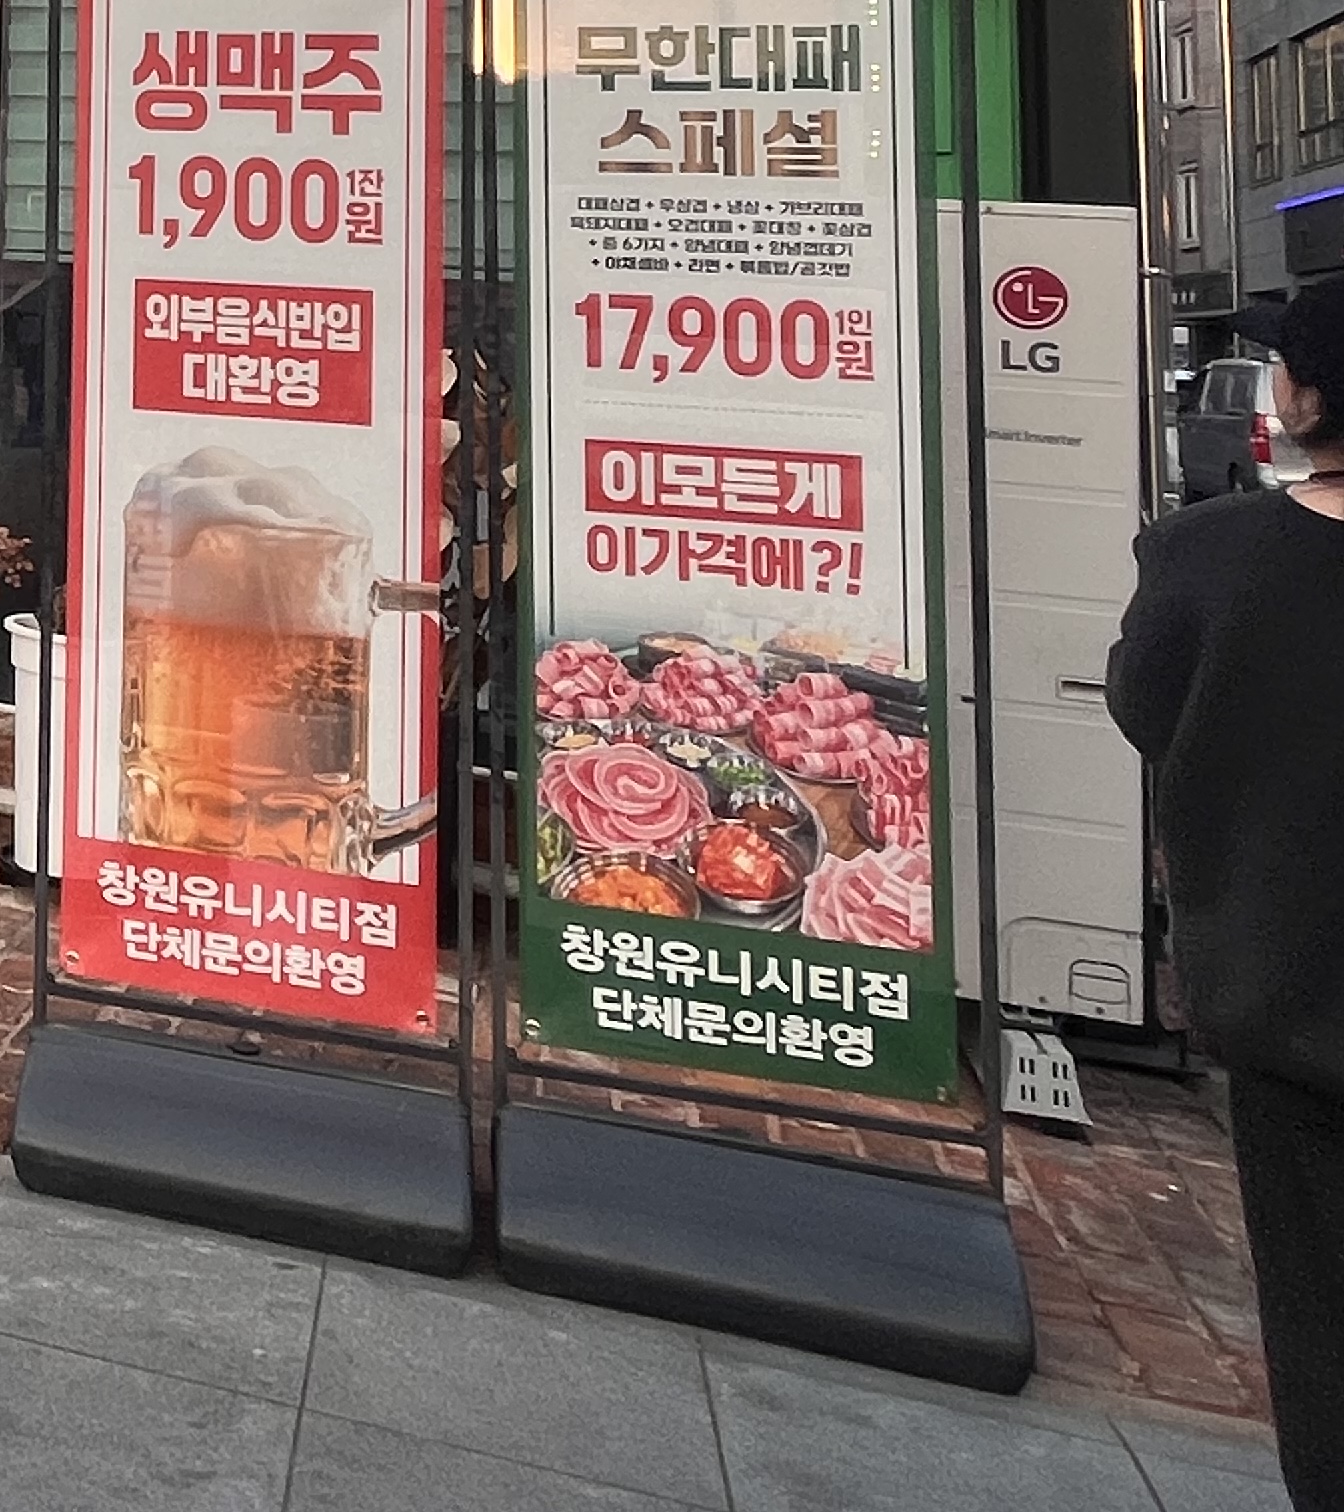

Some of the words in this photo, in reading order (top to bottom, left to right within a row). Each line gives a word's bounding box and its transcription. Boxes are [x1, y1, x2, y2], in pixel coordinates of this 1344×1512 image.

[133, 30, 382, 136] 생맥주
[576, 24, 862, 92] 무한대패
[598, 108, 840, 178] 스페셜
[128, 155, 340, 250] 1,900
[345, 201, 384, 245] 원
[144, 294, 361, 353] 외부음식반입
[574, 293, 830, 383] 17,900
[834, 309, 873, 337] 1인
[1000, 339, 1061, 373] LG
[182, 353, 321, 408] 대환영
[835, 340, 875, 382] 원
[601, 450, 843, 520] 이모든게
[586, 524, 863, 596] 이가격에?!
[97, 860, 399, 949] 창원유니시티점
[122, 918, 367, 996] 단체문의환영
[560, 923, 910, 1021] 창원유니시티점
[591, 986, 875, 1068] 단체문의환영
